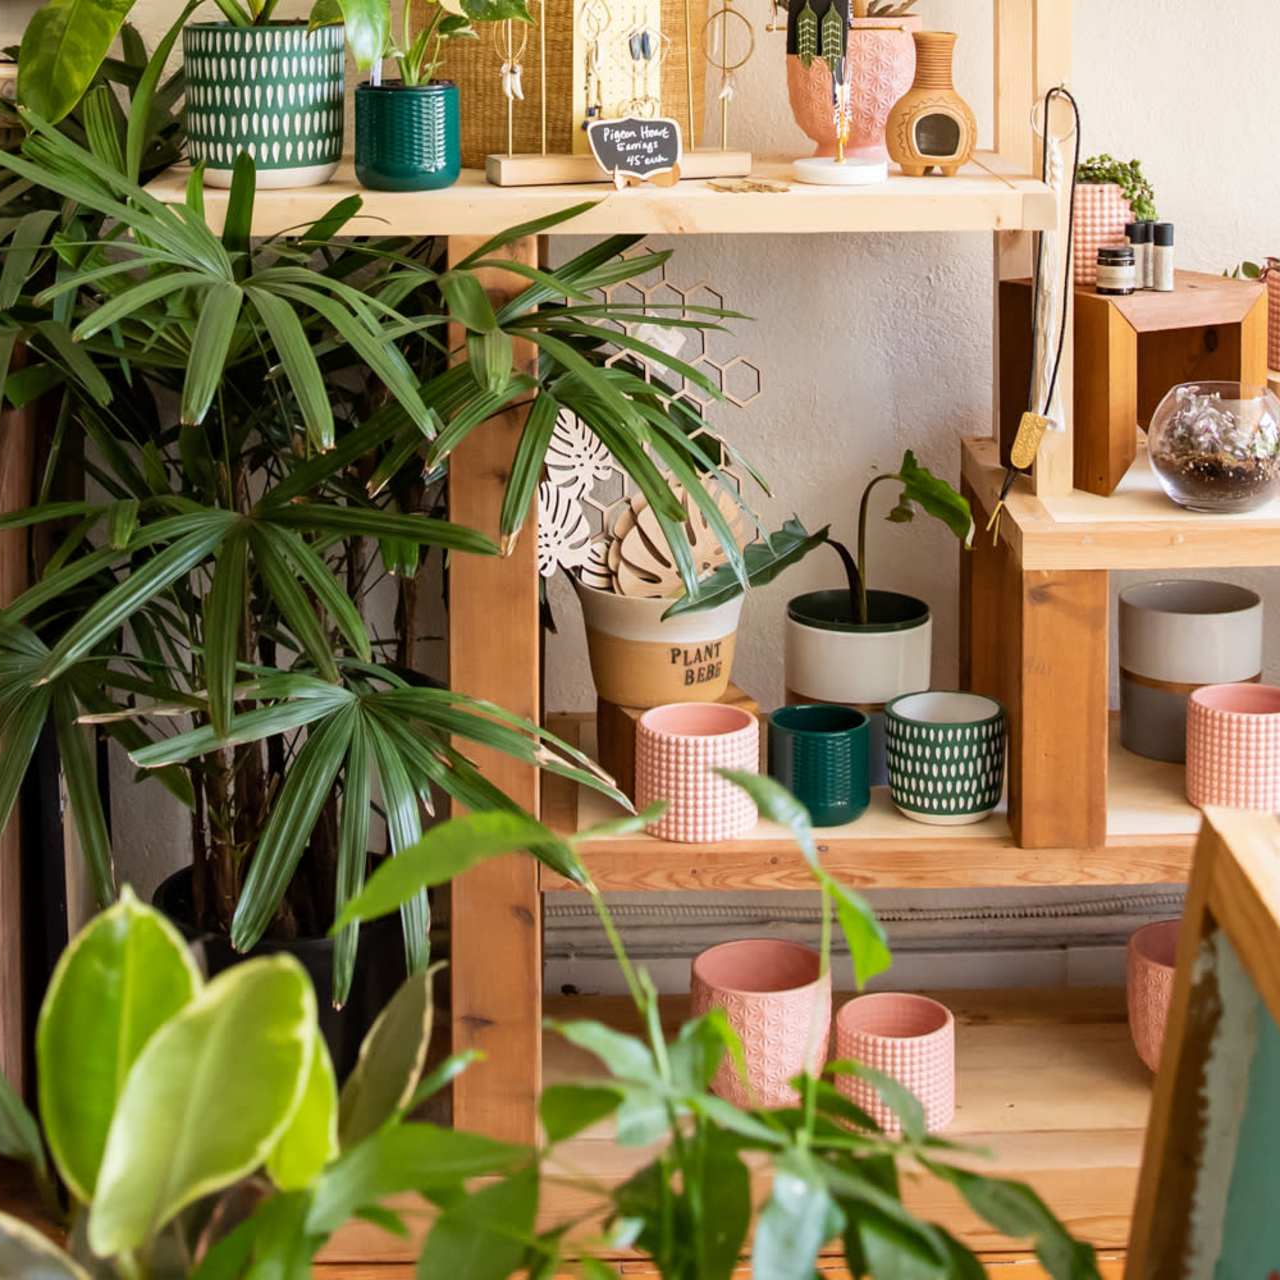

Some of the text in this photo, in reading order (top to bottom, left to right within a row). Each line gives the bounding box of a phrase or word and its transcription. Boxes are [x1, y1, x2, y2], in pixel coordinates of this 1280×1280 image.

[603, 127, 637, 142] Pigeon
[616, 140, 659, 154] Earrings
[671, 641, 723, 666] PLANT
[684, 662, 723, 687] BEBE
